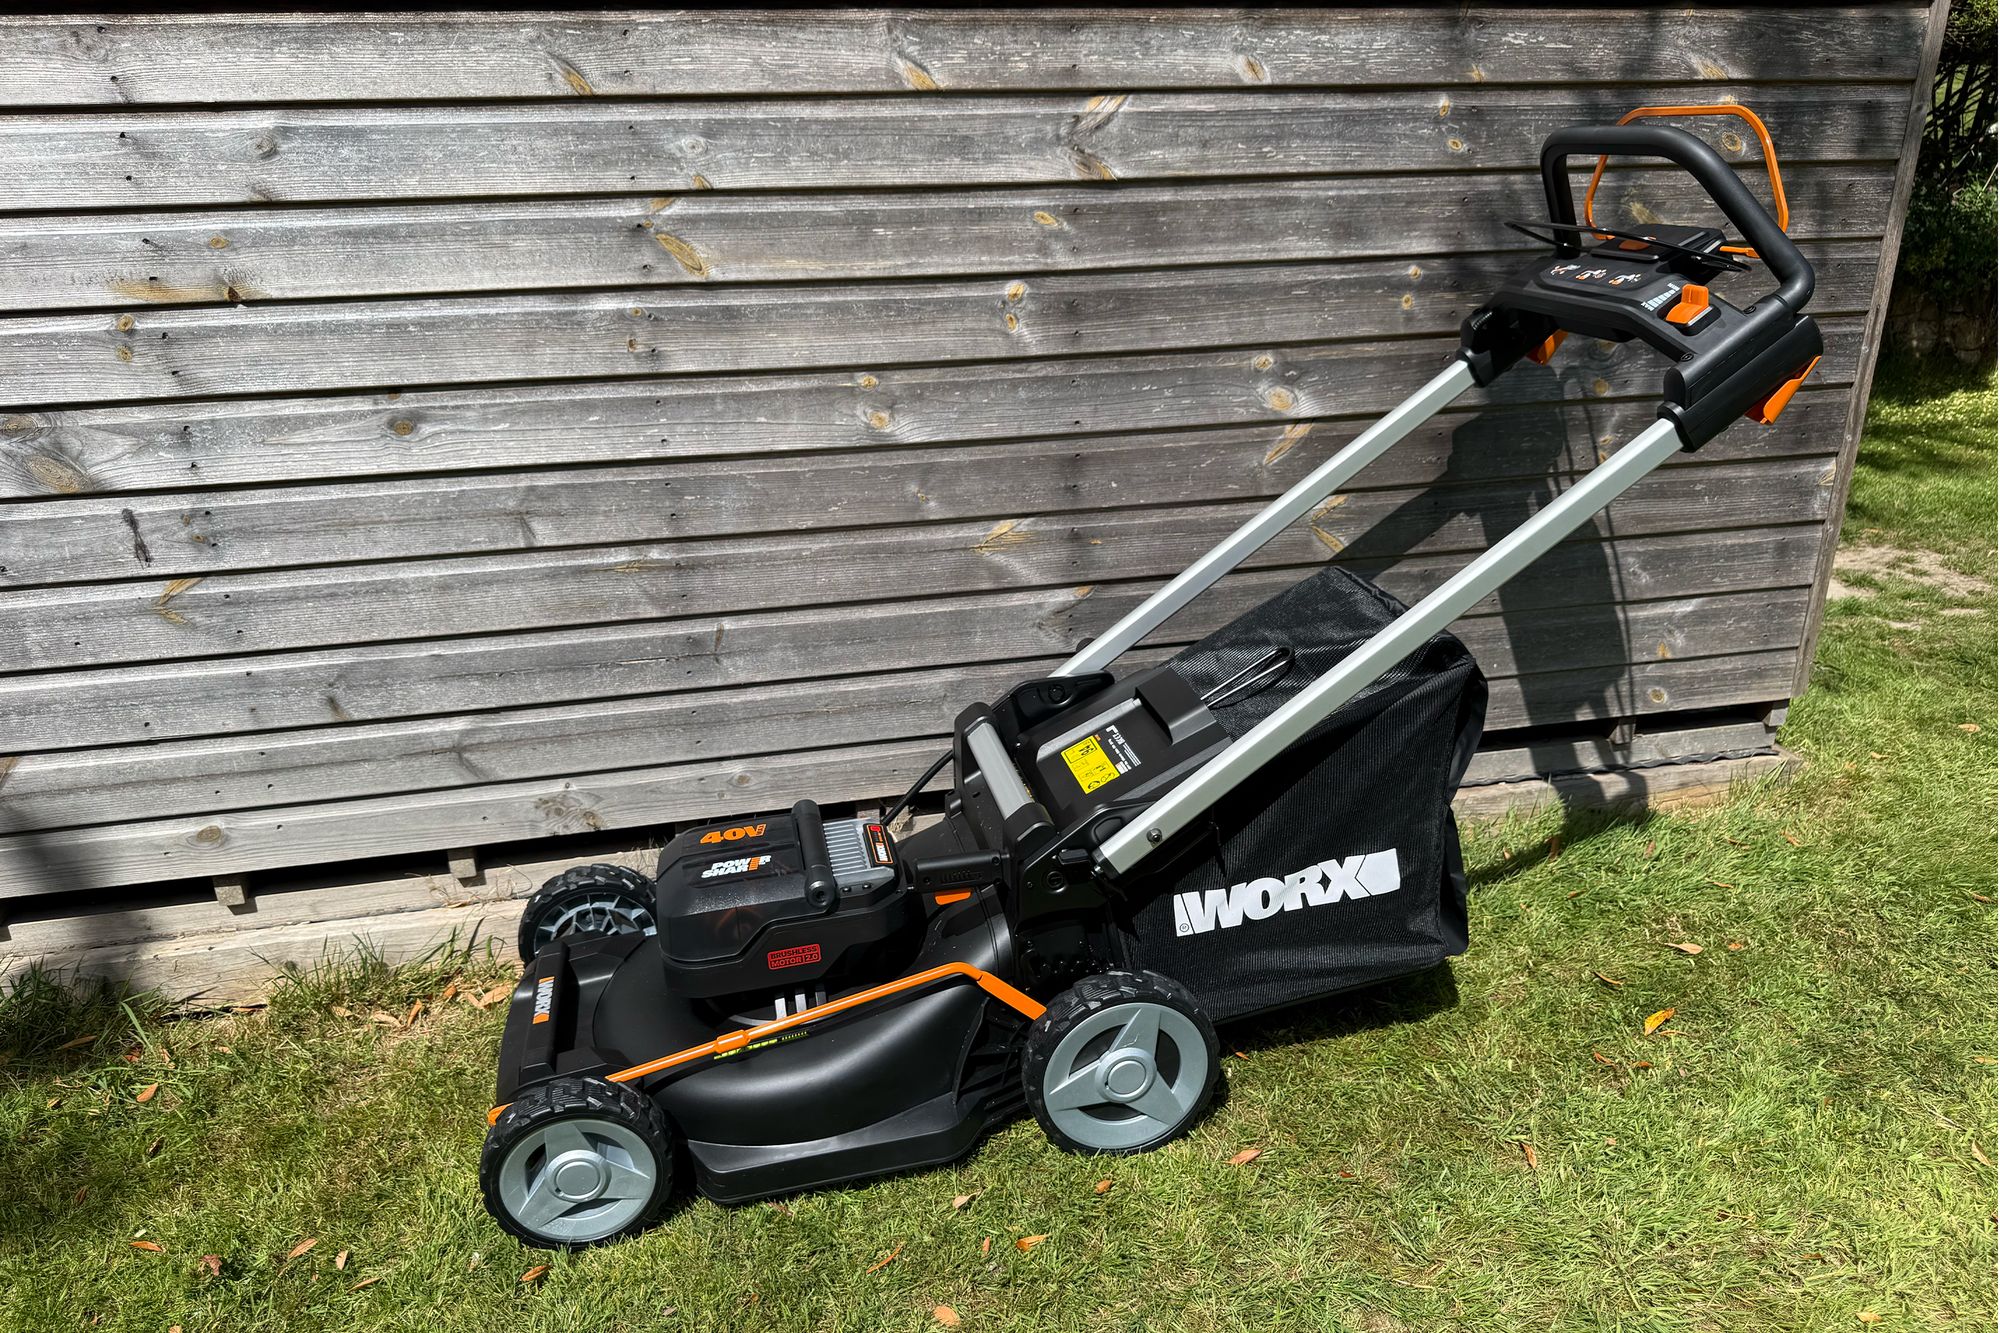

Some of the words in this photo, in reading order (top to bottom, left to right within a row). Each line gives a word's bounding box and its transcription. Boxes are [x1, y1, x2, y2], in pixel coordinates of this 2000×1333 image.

[711, 855, 772, 870] POWER
[701, 863, 759, 878] SHARE
[1181, 853, 1373, 935] WORX
[770, 945, 818, 959] BRUSHLESS
[771, 957, 802, 968] MOTOR
[804, 953, 818, 963] 2.0
[534, 979, 555, 1017] WORX
